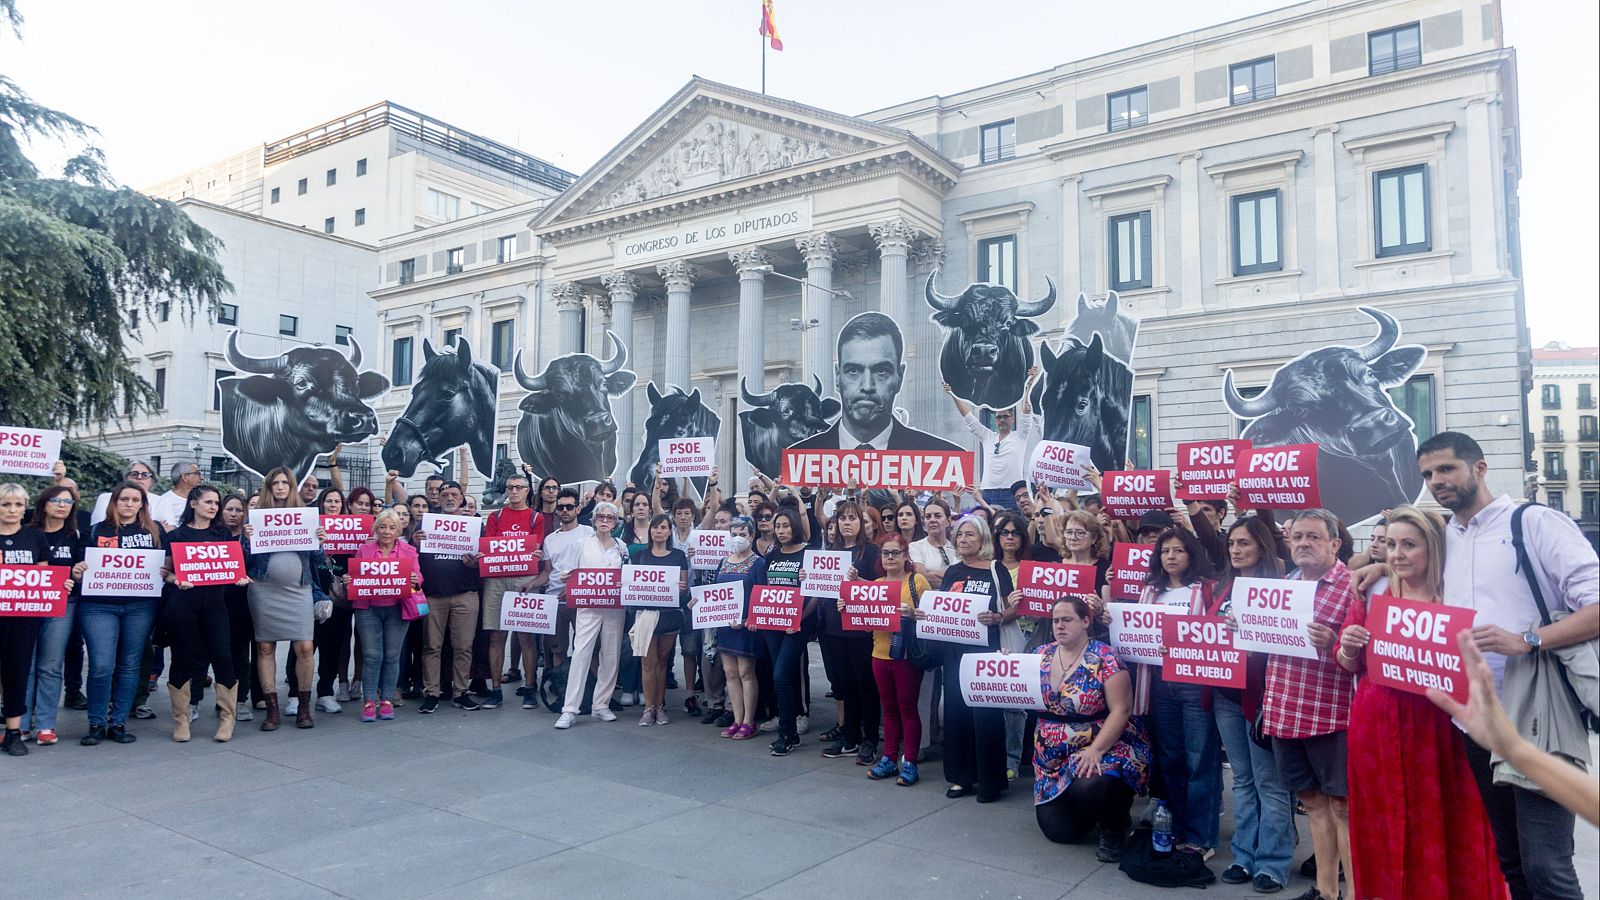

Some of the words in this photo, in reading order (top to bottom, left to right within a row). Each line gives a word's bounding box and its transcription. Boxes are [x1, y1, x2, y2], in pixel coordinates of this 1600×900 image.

[626, 236, 678, 255] CONGRESO
[686, 232, 698, 244] DE
[706, 227, 726, 240] LOS
[734, 212, 797, 234] DIPUTADOS
[670, 443, 700, 454] PSOE
[1043, 445, 1074, 464] PSOE
[1189, 446, 1234, 465] PSOE
[1249, 451, 1300, 472] PSOE
[2, 460, 49, 469] PODEROSOS
[787, 452, 966, 488] VERGÜENZA
[1036, 461, 1064, 473] COBARDE
[1066, 467, 1079, 476] CON
[1032, 471, 1043, 479] LOS
[1045, 474, 1084, 486] PODEROSOS
[1182, 470, 1211, 480] IGNORA
[1214, 470, 1225, 479] LA
[1114, 475, 1155, 492] PSOE
[1189, 484, 1204, 494] DEL
[1240, 478, 1274, 489] IGNORA
[1276, 478, 1289, 488] LA
[1290, 477, 1310, 487] VOZ
[1107, 496, 1135, 505] IGNORA
[1137, 497, 1148, 505] LA
[1149, 497, 1166, 505] VOZ
[1249, 493, 1268, 504] DEL
[1270, 493, 1305, 503] PUEBLO
[264, 513, 302, 526] PSOE
[325, 518, 362, 530] PSOE
[434, 520, 467, 532] PSOE
[271, 538, 312, 546] PODEROSOS
[438, 542, 473, 551] PODEROSOS
[490, 538, 525, 553] PSOE
[700, 535, 725, 546] PSOE
[185, 545, 229, 560] PSOE
[102, 555, 145, 568] PSOE
[180, 562, 210, 571] IGNORA
[212, 562, 222, 570] LA
[224, 561, 239, 569] VOZ
[360, 561, 399, 575] PSOE
[777, 560, 800, 568] anima
[813, 556, 840, 570] PSOE
[0, 569, 53, 587] PSOE
[188, 573, 203, 582] DEL
[205, 572, 235, 581] PUEBLO
[353, 578, 380, 586] IGNORA
[578, 572, 613, 585] PSOE
[634, 570, 665, 582] PSOE
[1032, 566, 1079, 588] PSOE
[27, 590, 40, 599] LA
[42, 591, 61, 600] VOZ
[358, 588, 372, 596] DEL
[374, 588, 401, 596] PUEBLO
[704, 588, 734, 602] PSOE
[760, 589, 794, 604] PSOE
[851, 586, 888, 600] PSOE
[1248, 587, 1293, 610] PSOE
[15, 603, 52, 612] PUEBLO
[514, 597, 545, 610] PSOE
[700, 604, 727, 612] COBARDE
[846, 605, 869, 613] IGNORA
[933, 596, 971, 614] PSOE
[1030, 602, 1045, 611] DEL
[753, 606, 774, 614] IGNORA
[776, 607, 784, 615] LA
[769, 618, 792, 626] PUEBLO
[852, 617, 863, 625] DEL
[864, 617, 889, 626] PUEBLO
[926, 614, 958, 625] COBARDE
[960, 619, 976, 627] CON
[1242, 614, 1278, 626] COBARDE
[1281, 619, 1298, 629] CON
[1386, 606, 1450, 644] PSOE
[922, 625, 935, 633] LOS
[937, 627, 980, 639] PODEROSOS
[1119, 633, 1154, 643] COBARDE
[1177, 621, 1230, 644] PSOE
[1240, 629, 1253, 640] LOS
[1255, 632, 1305, 647] PODEROSOS
[1170, 647, 1204, 660] IGNORA
[1207, 650, 1219, 661] LA
[1221, 651, 1239, 663] VOZ
[1373, 640, 1415, 661] IGNORA
[1418, 649, 1433, 665] LA
[1435, 652, 1460, 672] VOZ
[976, 660, 1020, 677] PSOE
[1176, 664, 1193, 676] DEL
[1196, 667, 1232, 680] PUEBLO
[1382, 663, 1404, 682] DEL
[1406, 669, 1453, 693] PUEBLO
[970, 682, 1008, 692] COBARDE
[1010, 684, 1027, 692] CON
[968, 694, 984, 702] LOS
[986, 696, 1035, 704] PODEROSOS
